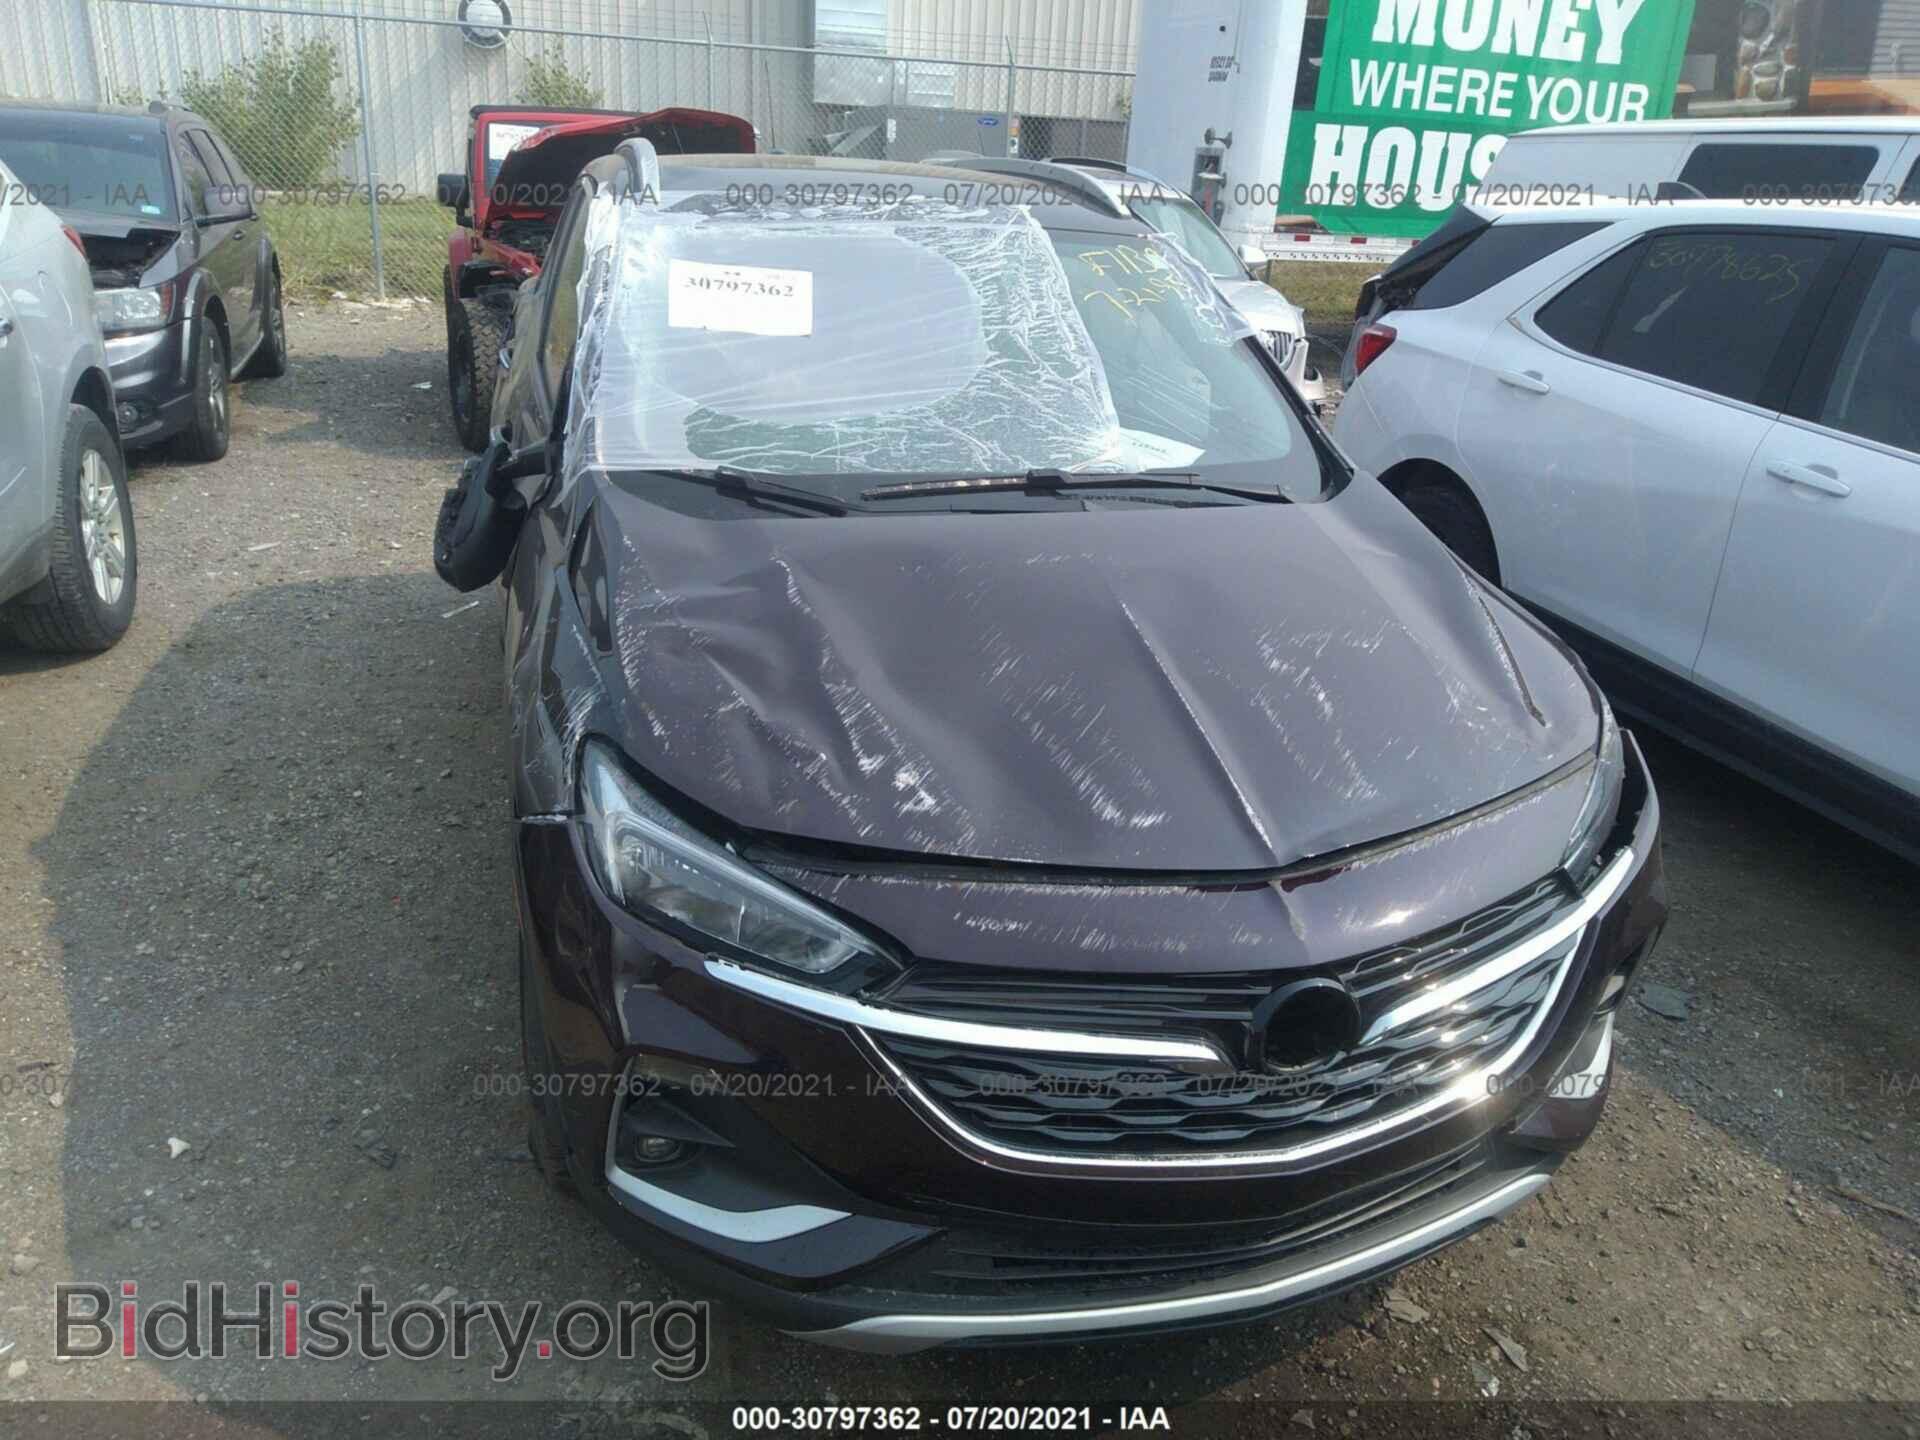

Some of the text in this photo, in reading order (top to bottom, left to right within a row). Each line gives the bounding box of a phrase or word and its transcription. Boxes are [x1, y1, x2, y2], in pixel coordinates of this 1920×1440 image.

[1371, 0, 1646, 65] MONEY
[1350, 58, 1650, 124] WHERE YOUR
[684, 275, 795, 298] 30797362
